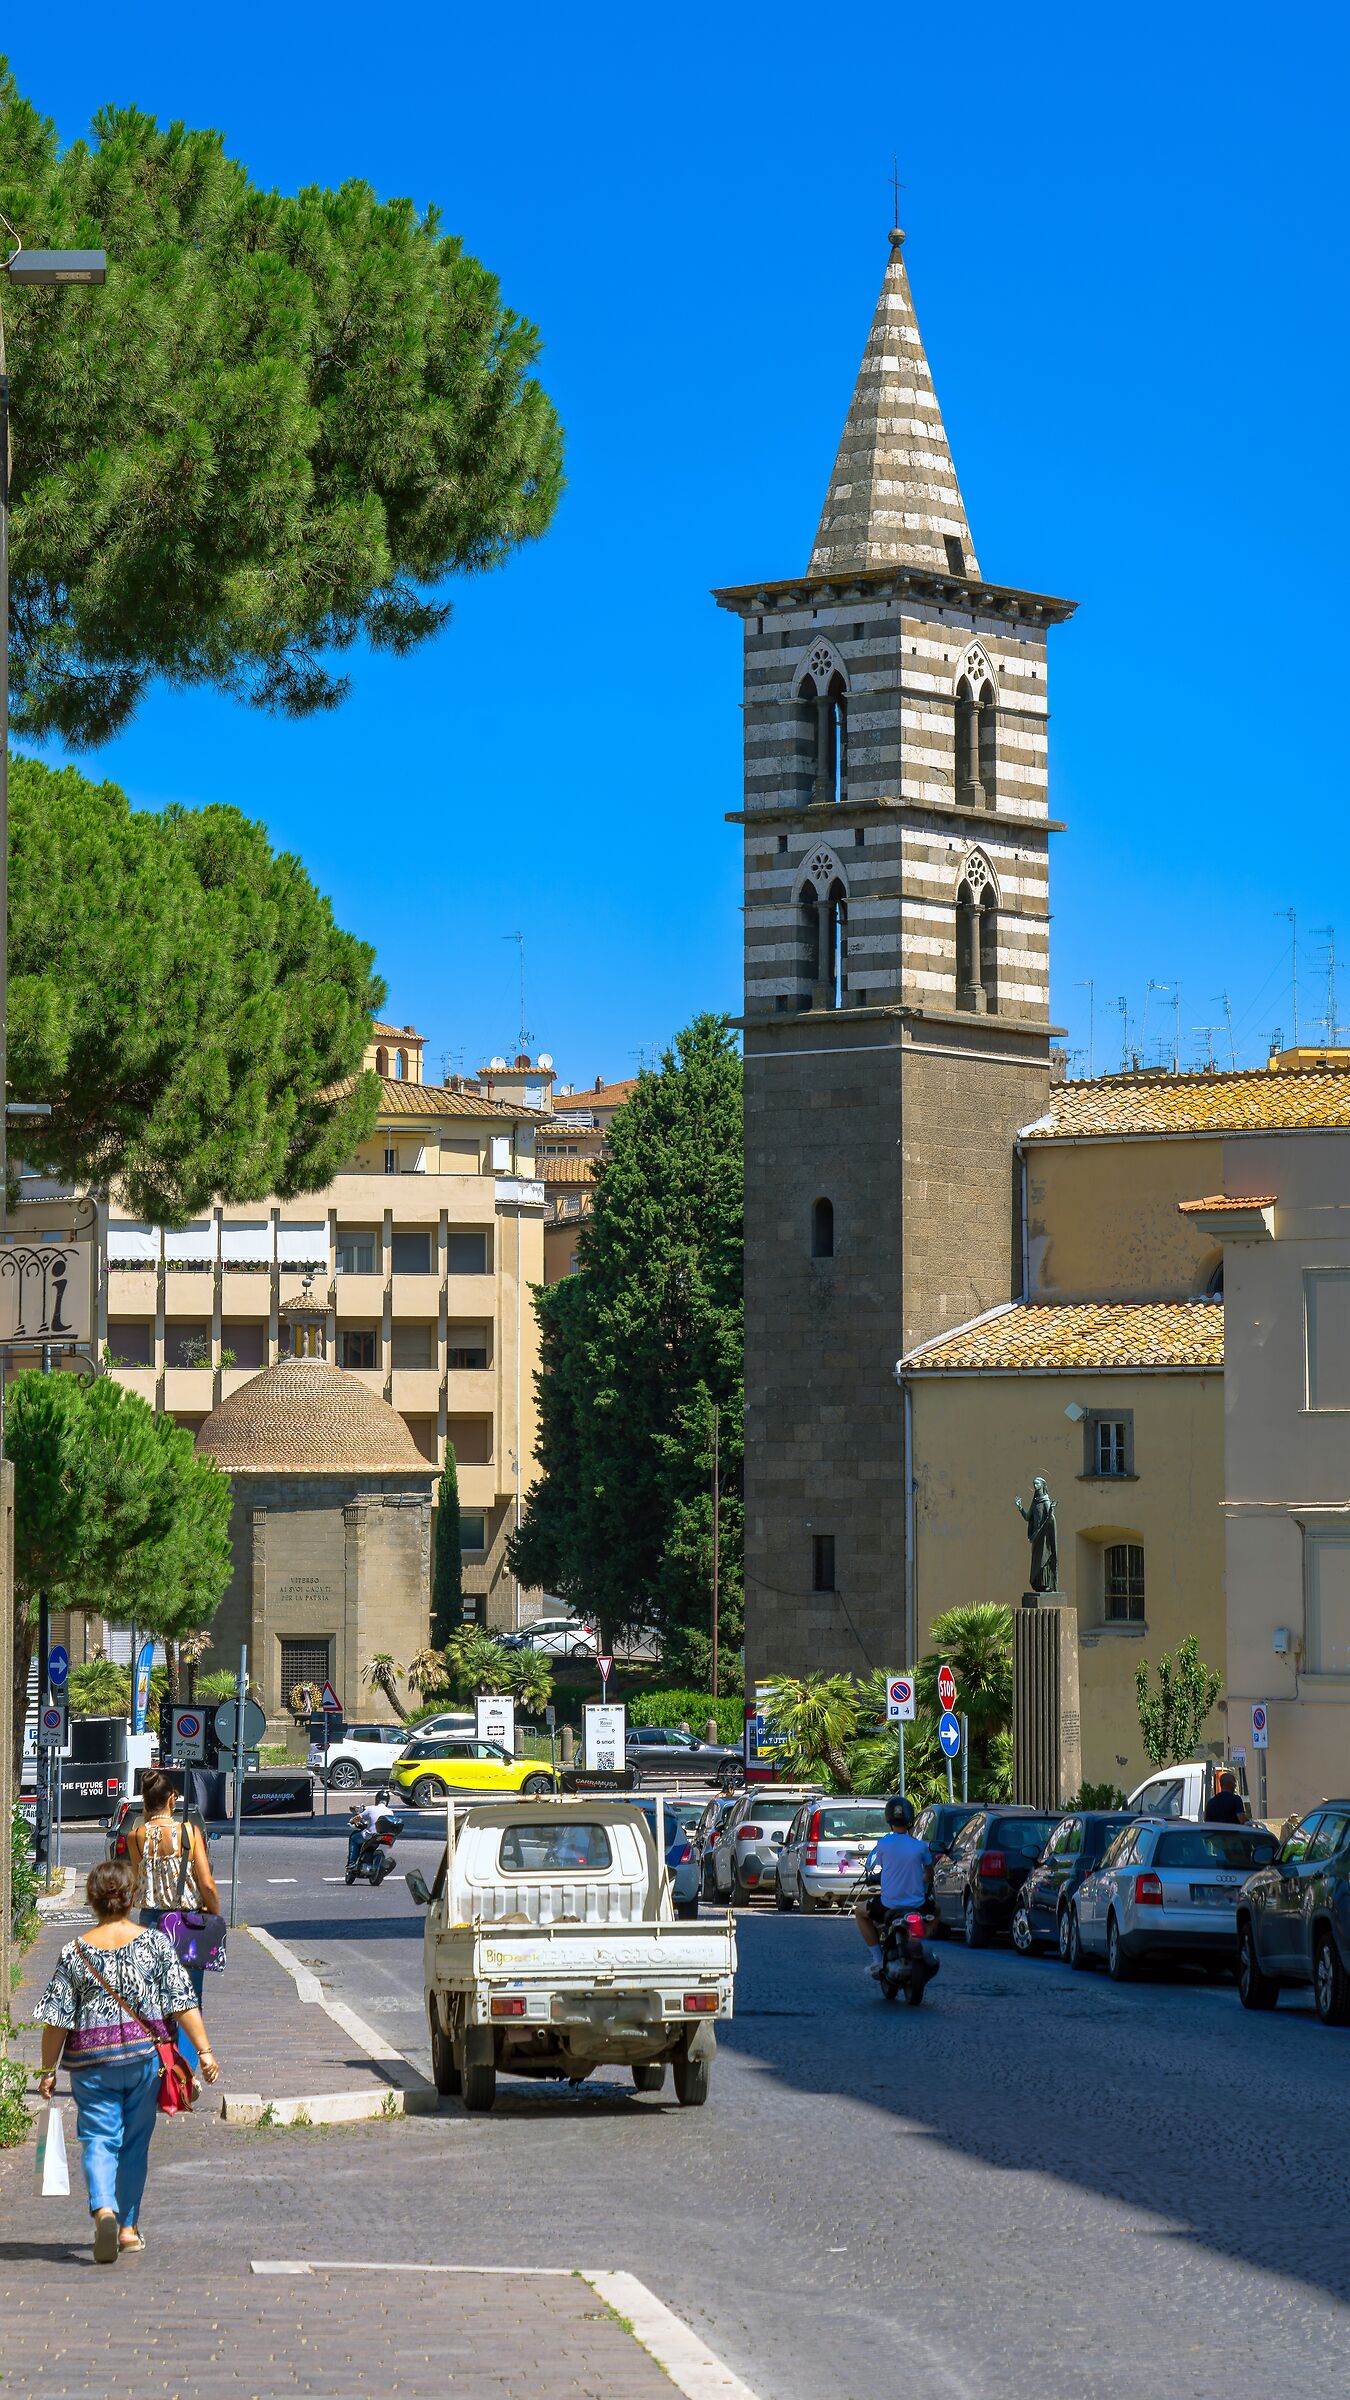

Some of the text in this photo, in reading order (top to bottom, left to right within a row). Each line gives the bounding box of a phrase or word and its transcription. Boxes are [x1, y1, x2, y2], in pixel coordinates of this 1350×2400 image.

[940, 1680, 954, 1697] STOP
[75, 1781, 104, 1790] FUTURE
[118, 1782, 129, 1791] FO
[89, 1788, 104, 1796] YOU
